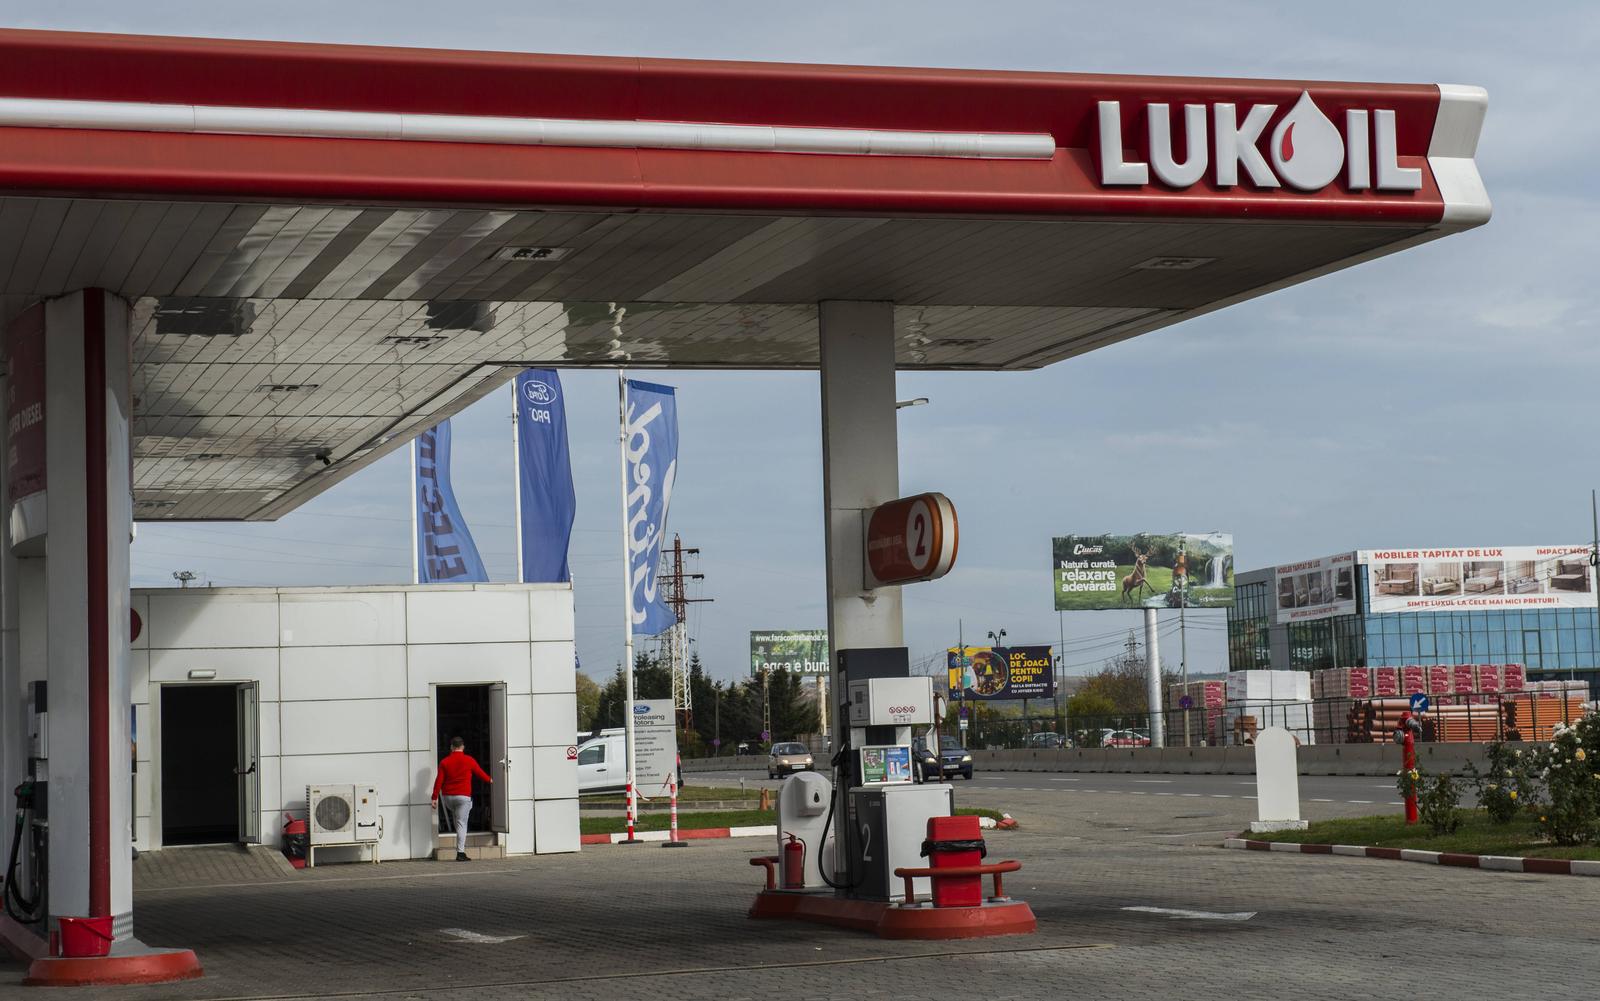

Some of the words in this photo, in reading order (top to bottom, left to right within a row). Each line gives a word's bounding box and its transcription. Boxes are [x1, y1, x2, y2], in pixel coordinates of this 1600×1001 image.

[1098, 90, 1422, 191] LUKOIL
[21, 401, 43, 429] DIESEL
[914, 513, 926, 556] 2
[1374, 551, 1419, 560] MOBILER
[1422, 550, 1464, 558] TAPITAT
[1483, 549, 1503, 557] LUX
[1061, 560, 1089, 569] Natură
[1091, 560, 1117, 569] curată,
[1062, 569, 1116, 581] relaxare
[1062, 580, 1117, 592] adevărată
[1010, 652, 1026, 660] LOC
[1010, 660, 1021, 668] DE
[1023, 658, 1049, 667] JOACĂ
[1010, 667, 1043, 675] PENTRU
[1011, 675, 1033, 683] COPII
[862, 823, 873, 862] 2
